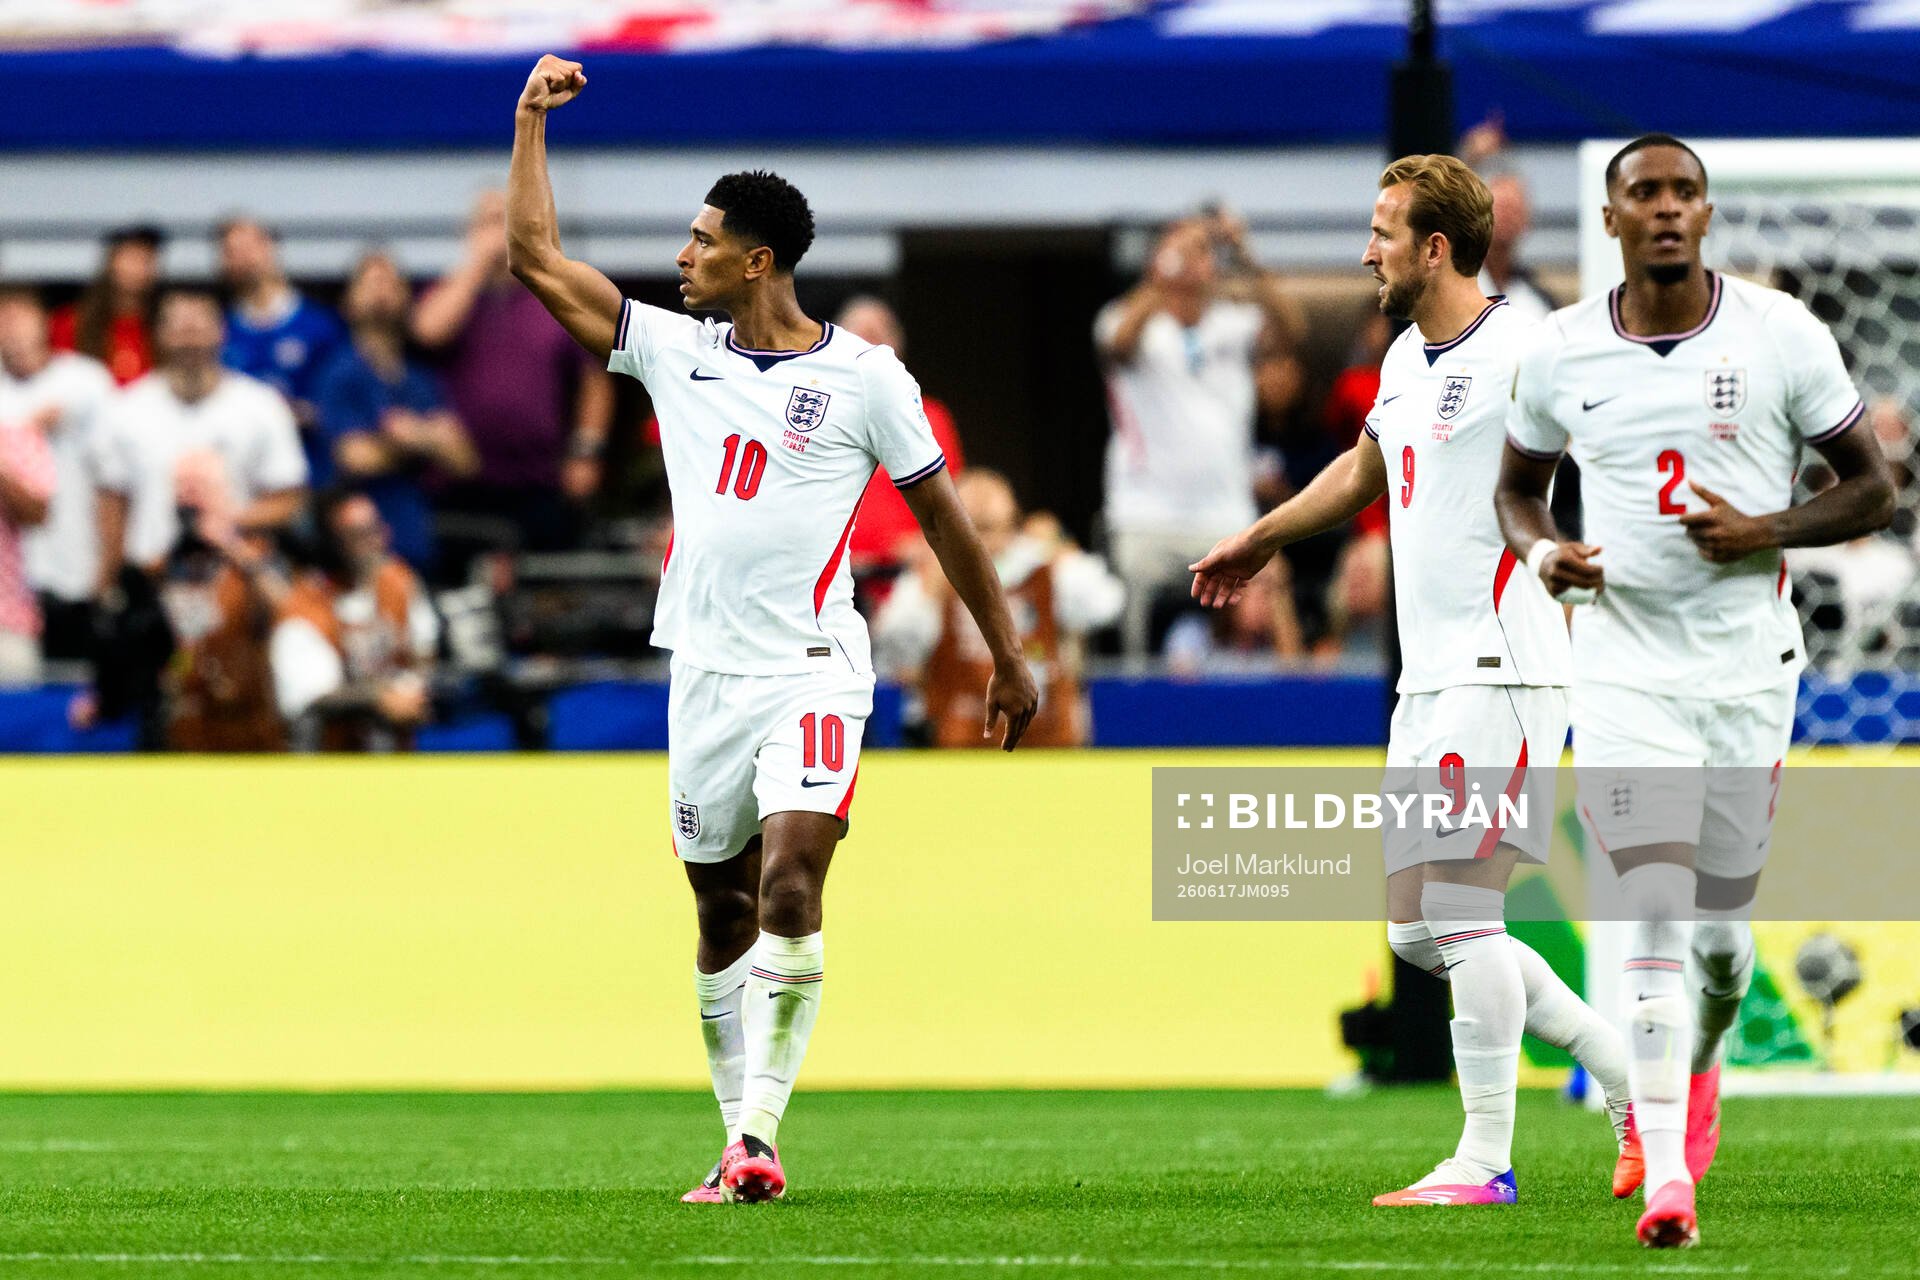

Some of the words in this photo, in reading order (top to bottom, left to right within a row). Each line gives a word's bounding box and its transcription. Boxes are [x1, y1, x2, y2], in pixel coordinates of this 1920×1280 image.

[716, 433, 768, 501] 10
[783, 430, 810, 444] CROATIA
[1401, 445, 1415, 508] 9
[1656, 449, 1687, 515] 2
[799, 711, 845, 773] 10
[1439, 752, 1467, 816] 9
